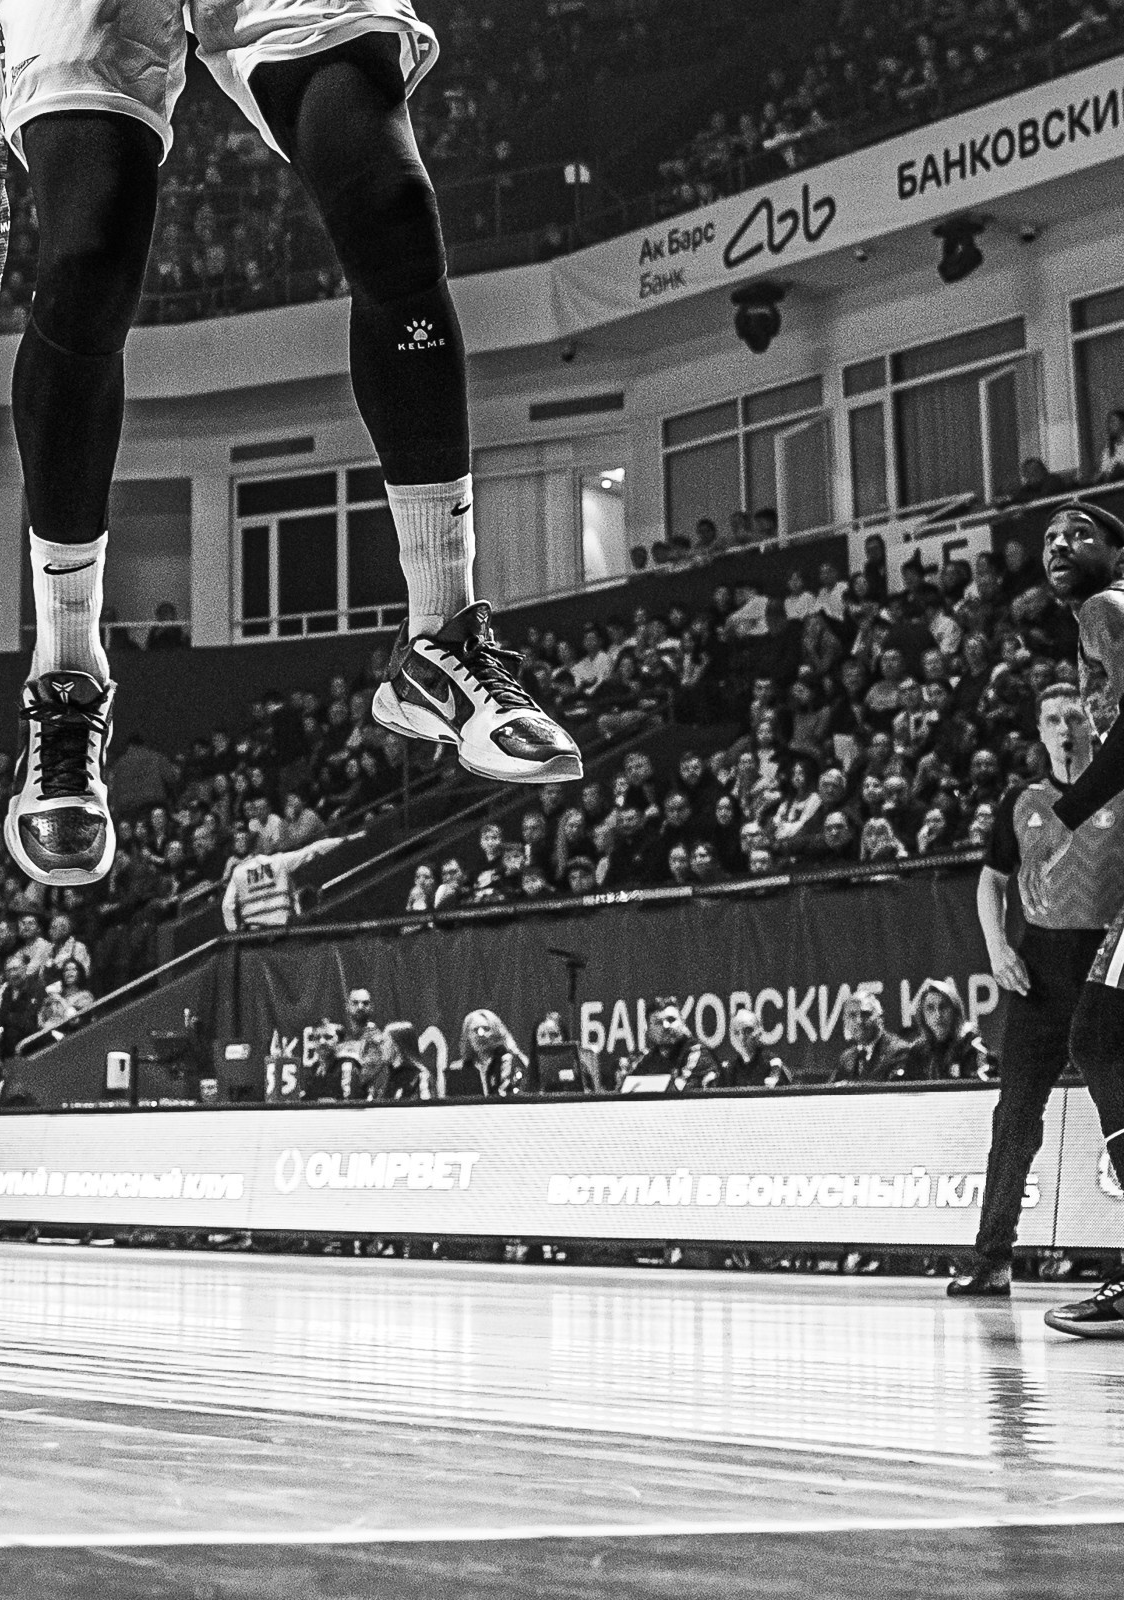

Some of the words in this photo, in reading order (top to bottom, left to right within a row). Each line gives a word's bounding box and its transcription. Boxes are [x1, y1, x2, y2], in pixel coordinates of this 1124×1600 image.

[897, 86, 1124, 200] БАНКОВСКИ
[639, 238, 666, 266] Ак
[668, 220, 716, 257] Барс
[639, 267, 688, 299] Банк
[397, 338, 446, 351] KELME
[306, 1151, 480, 1190] OLIMPBET
[547, 1167, 692, 1207] ВСТУПАЙ
[695, 1174, 725, 1207] В
[726, 1166, 931, 1208] БОНУСНЫЙ
[934, 1174, 1040, 1209] КЛБ
